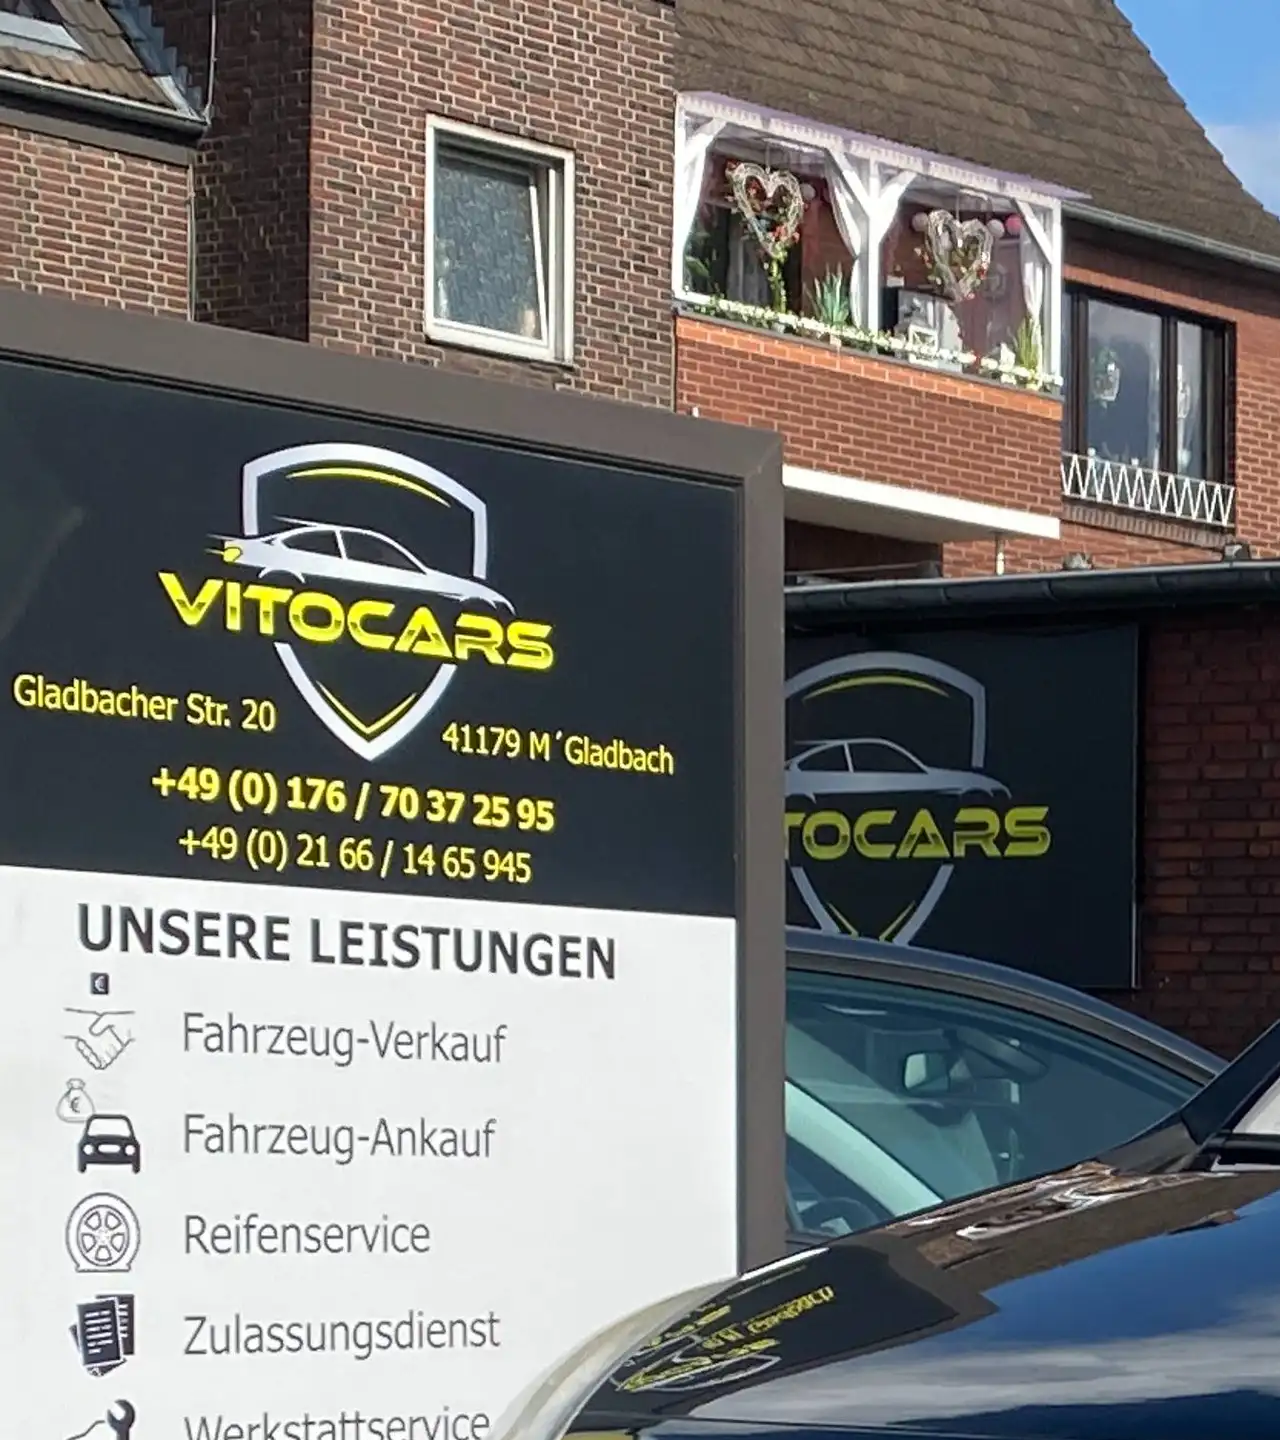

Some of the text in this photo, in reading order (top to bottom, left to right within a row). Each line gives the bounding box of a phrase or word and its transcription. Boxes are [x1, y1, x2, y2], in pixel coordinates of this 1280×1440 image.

[158, 572, 555, 671] VITOCARS
[12, 674, 275, 731] Gladbacher Str. 20
[442, 727, 520, 757] 41179
[153, 767, 218, 801] +49
[229, 771, 275, 812] (0)
[287, 777, 345, 811] 176
[380, 785, 418, 820] 70
[426, 789, 464, 824] 37
[473, 794, 510, 827] 25
[517, 797, 554, 831] 95
[179, 827, 238, 859] +49
[246, 831, 288, 871] (0)
[297, 836, 329, 868] 21
[339, 837, 373, 871] 66
[403, 842, 436, 875] 14
[442, 846, 475, 878] 65
[484, 849, 531, 883] 945
[78, 903, 616, 980] UNSERE LEISTUNGEN
[183, 1012, 507, 1067] Fahrzeug-Verkauf
[183, 1113, 496, 1164] Fahrzeug-Ankauf
[184, 1214, 431, 1255] Reifenservice
[184, 1310, 500, 1359] Zulassungsdienst
